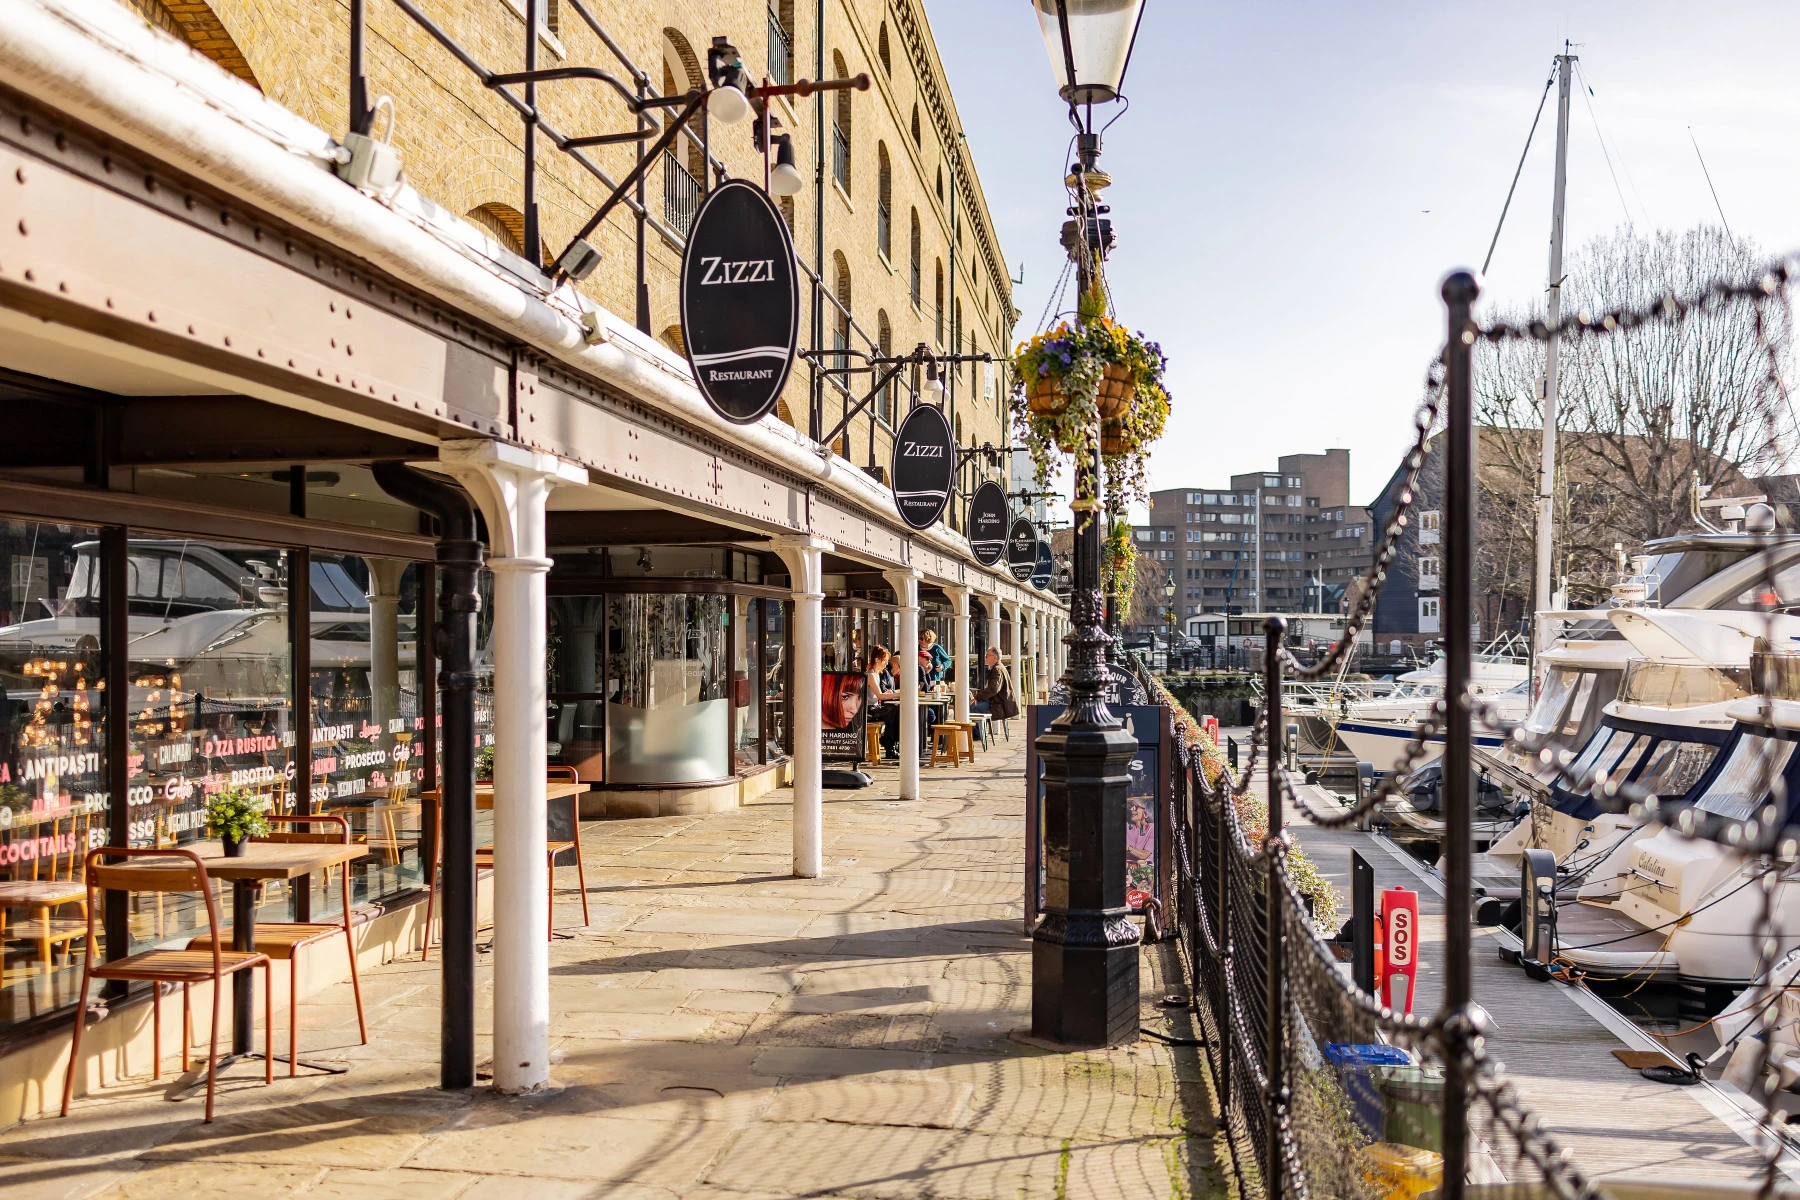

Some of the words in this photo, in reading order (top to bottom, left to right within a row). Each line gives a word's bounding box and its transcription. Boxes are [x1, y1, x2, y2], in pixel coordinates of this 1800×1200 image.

[700, 256, 775, 285] ZIZZI
[708, 369, 774, 382] RESTAURANT
[903, 441, 944, 458] ZIZZI
[903, 500, 938, 508] RESTAURANT
[311, 724, 354, 743] ANTIPASTI
[204, 739, 234, 758] PZZA
[236, 735, 277, 755] RUSTICA
[25, 752, 99, 780] ANTIPASTI
[345, 750, 386, 769] PROSECCO
[231, 765, 275, 786] RISOTTO
[0, 832, 76, 865] COCKTAILS
[1394, 913, 1408, 961] SOS
